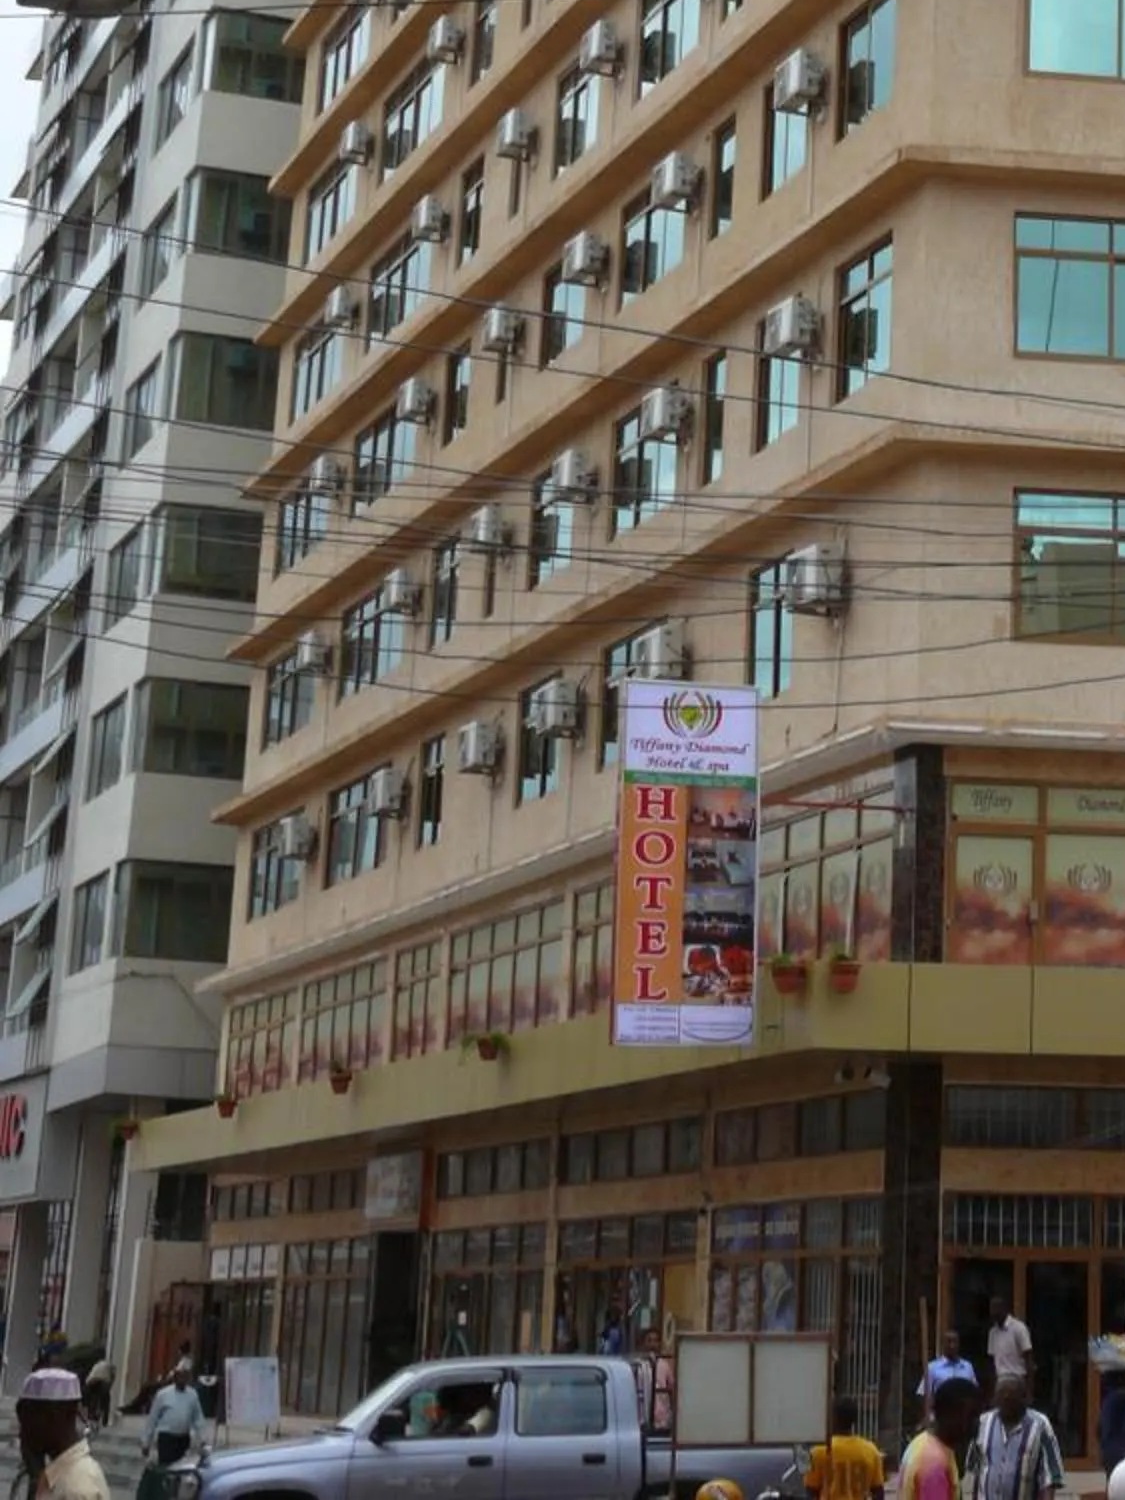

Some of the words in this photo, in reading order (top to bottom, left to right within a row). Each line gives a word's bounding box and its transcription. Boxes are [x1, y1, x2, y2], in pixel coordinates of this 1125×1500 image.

[631, 738, 681, 754] Tiffany
[685, 741, 751, 755] Diamond
[645, 757, 688, 769] Hotel
[634, 785, 677, 1001] HOTEL
